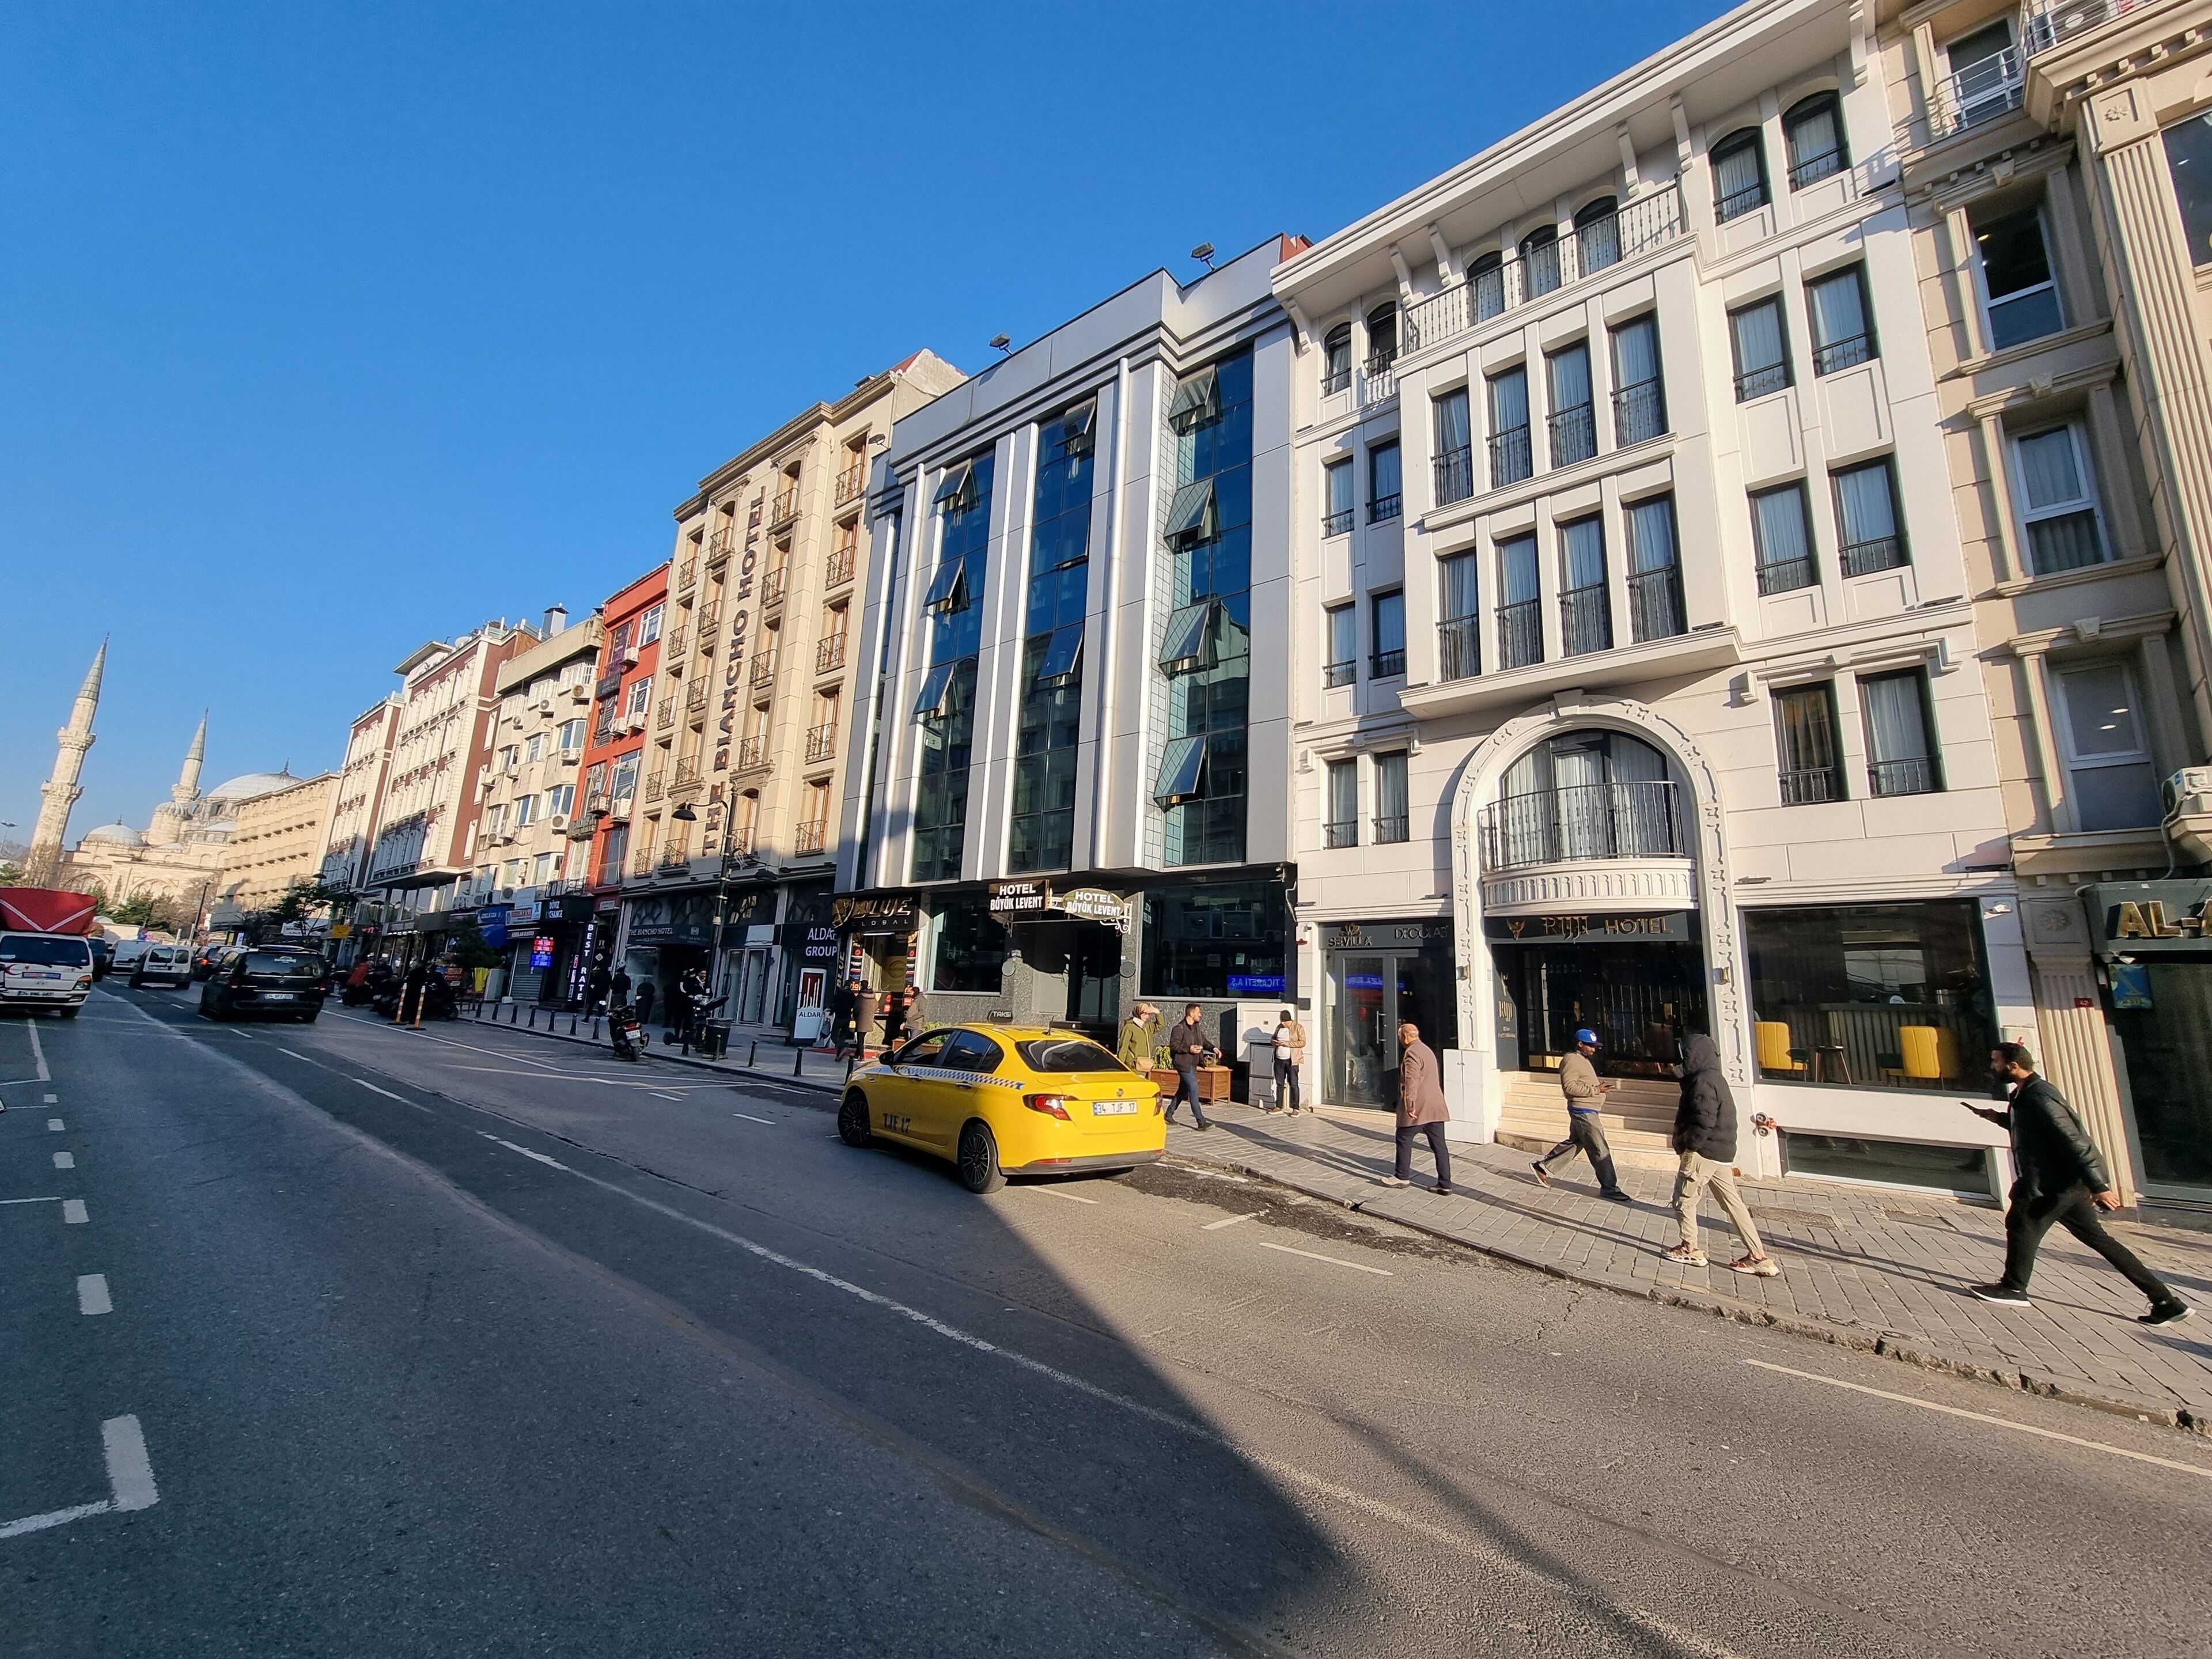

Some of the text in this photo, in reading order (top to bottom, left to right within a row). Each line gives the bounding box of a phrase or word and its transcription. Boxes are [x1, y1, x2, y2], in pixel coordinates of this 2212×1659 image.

[702, 485, 766, 857] THE BIANCHO HOTEL
[999, 883, 1036, 896] HOTEL
[990, 896, 1043, 911] BÜYÜK LEVENT
[1075, 891, 1114, 904] HOTEL
[1066, 901, 1121, 916] BÜYÜK LEVENT
[1604, 917, 1673, 935] HOTEL
[1328, 935, 1373, 946] SEVILLA
[805, 946, 837, 956] GROUP
[577, 924, 594, 1000] BEST RATE
[1097, 1103, 1135, 1113] 34 TJF 17
[902, 1118, 911, 1134] 17
